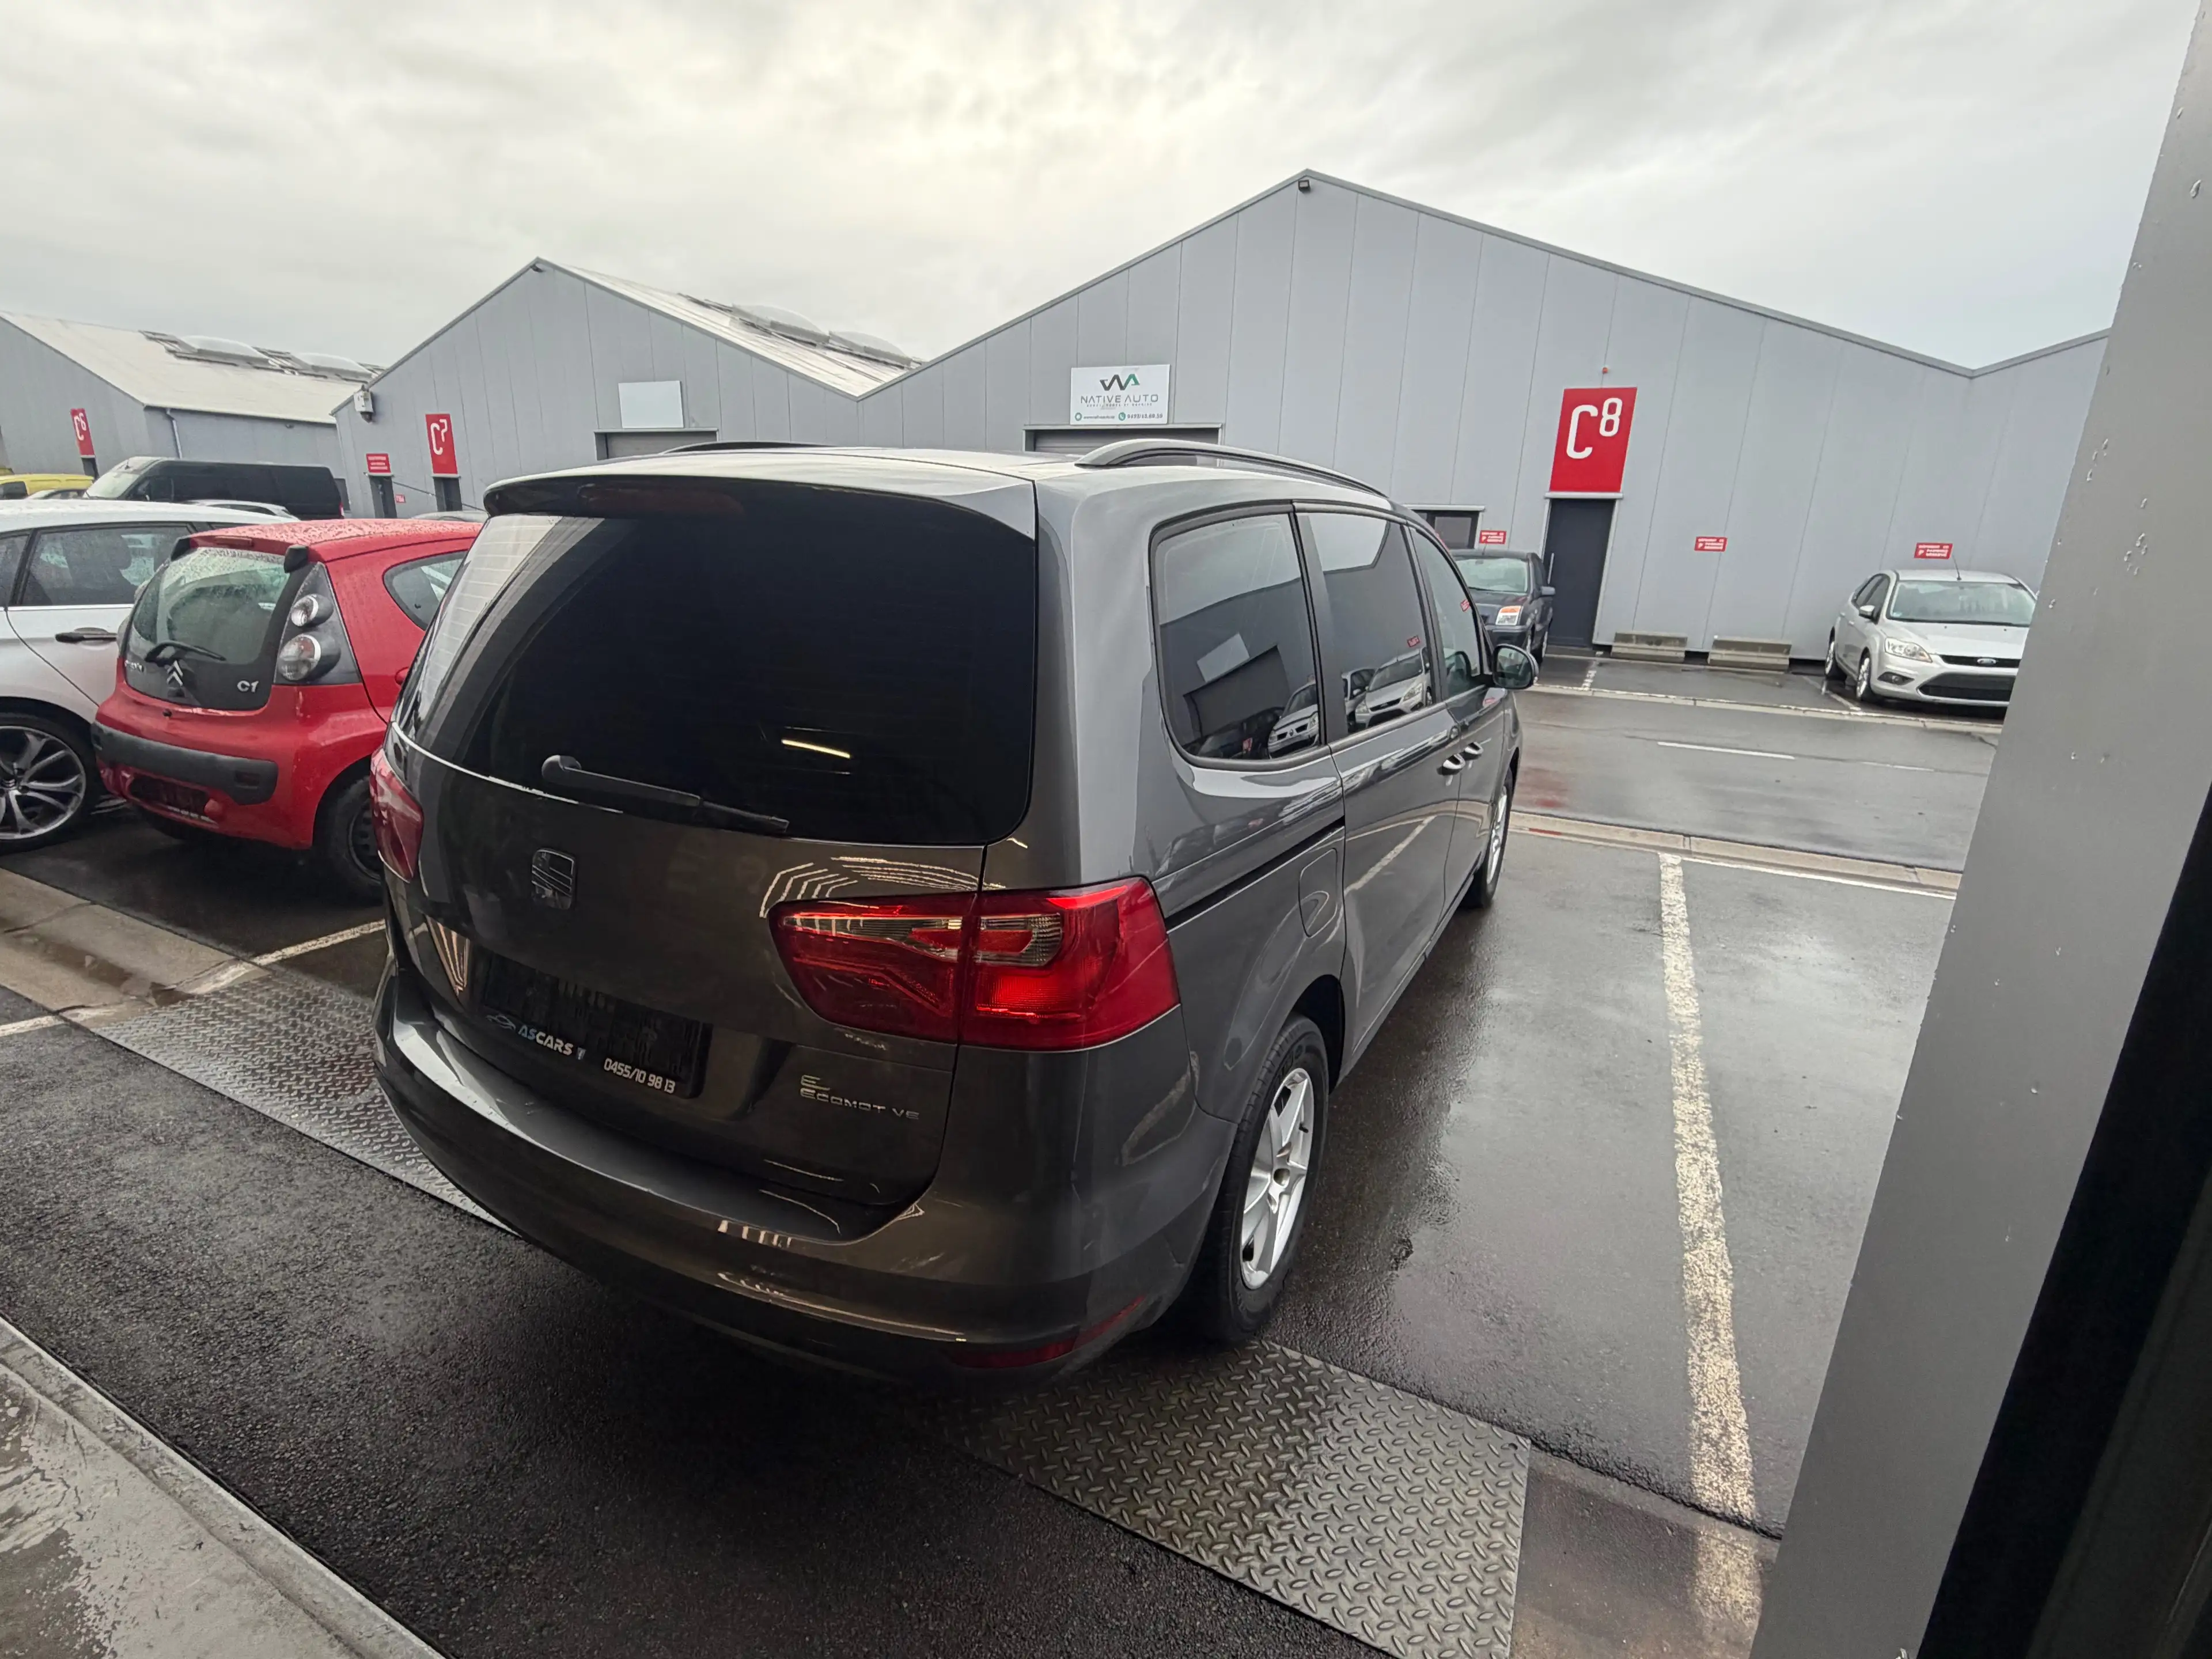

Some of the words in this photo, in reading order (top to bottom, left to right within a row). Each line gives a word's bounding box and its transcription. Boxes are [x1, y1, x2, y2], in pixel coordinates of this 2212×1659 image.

[1081, 395, 1121, 404] NATIVE
[1124, 394, 1159, 403] AUTO
[430, 418, 448, 455] C7
[1566, 397, 1623, 459] C8
[237, 680, 259, 692] C1
[604, 1058, 646, 1084] 0455/10
[647, 1073, 662, 1089] 98
[800, 1088, 919, 1120] ECOMOTVE
